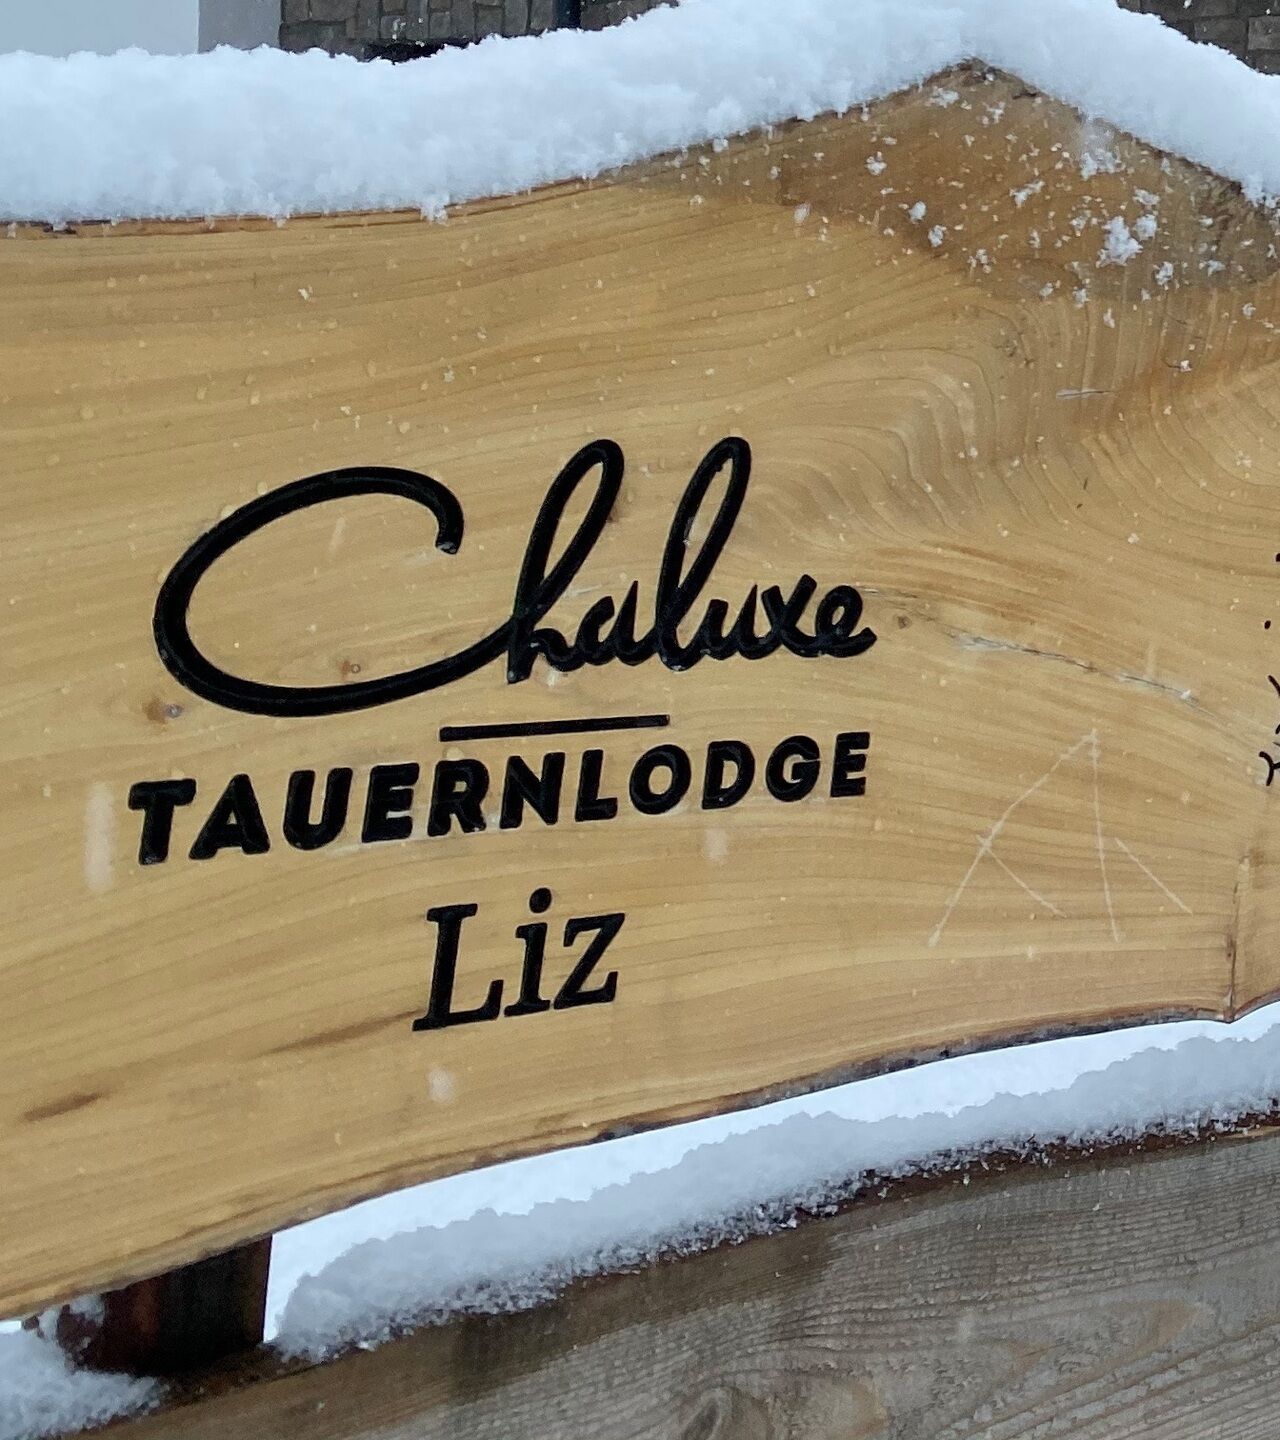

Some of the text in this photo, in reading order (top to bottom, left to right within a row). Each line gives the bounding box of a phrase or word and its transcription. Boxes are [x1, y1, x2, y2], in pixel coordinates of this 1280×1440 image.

[152, 436, 878, 718] Chaluxe
[127, 731, 871, 866] TAUERNLODGE
[411, 887, 626, 1032] Liz
